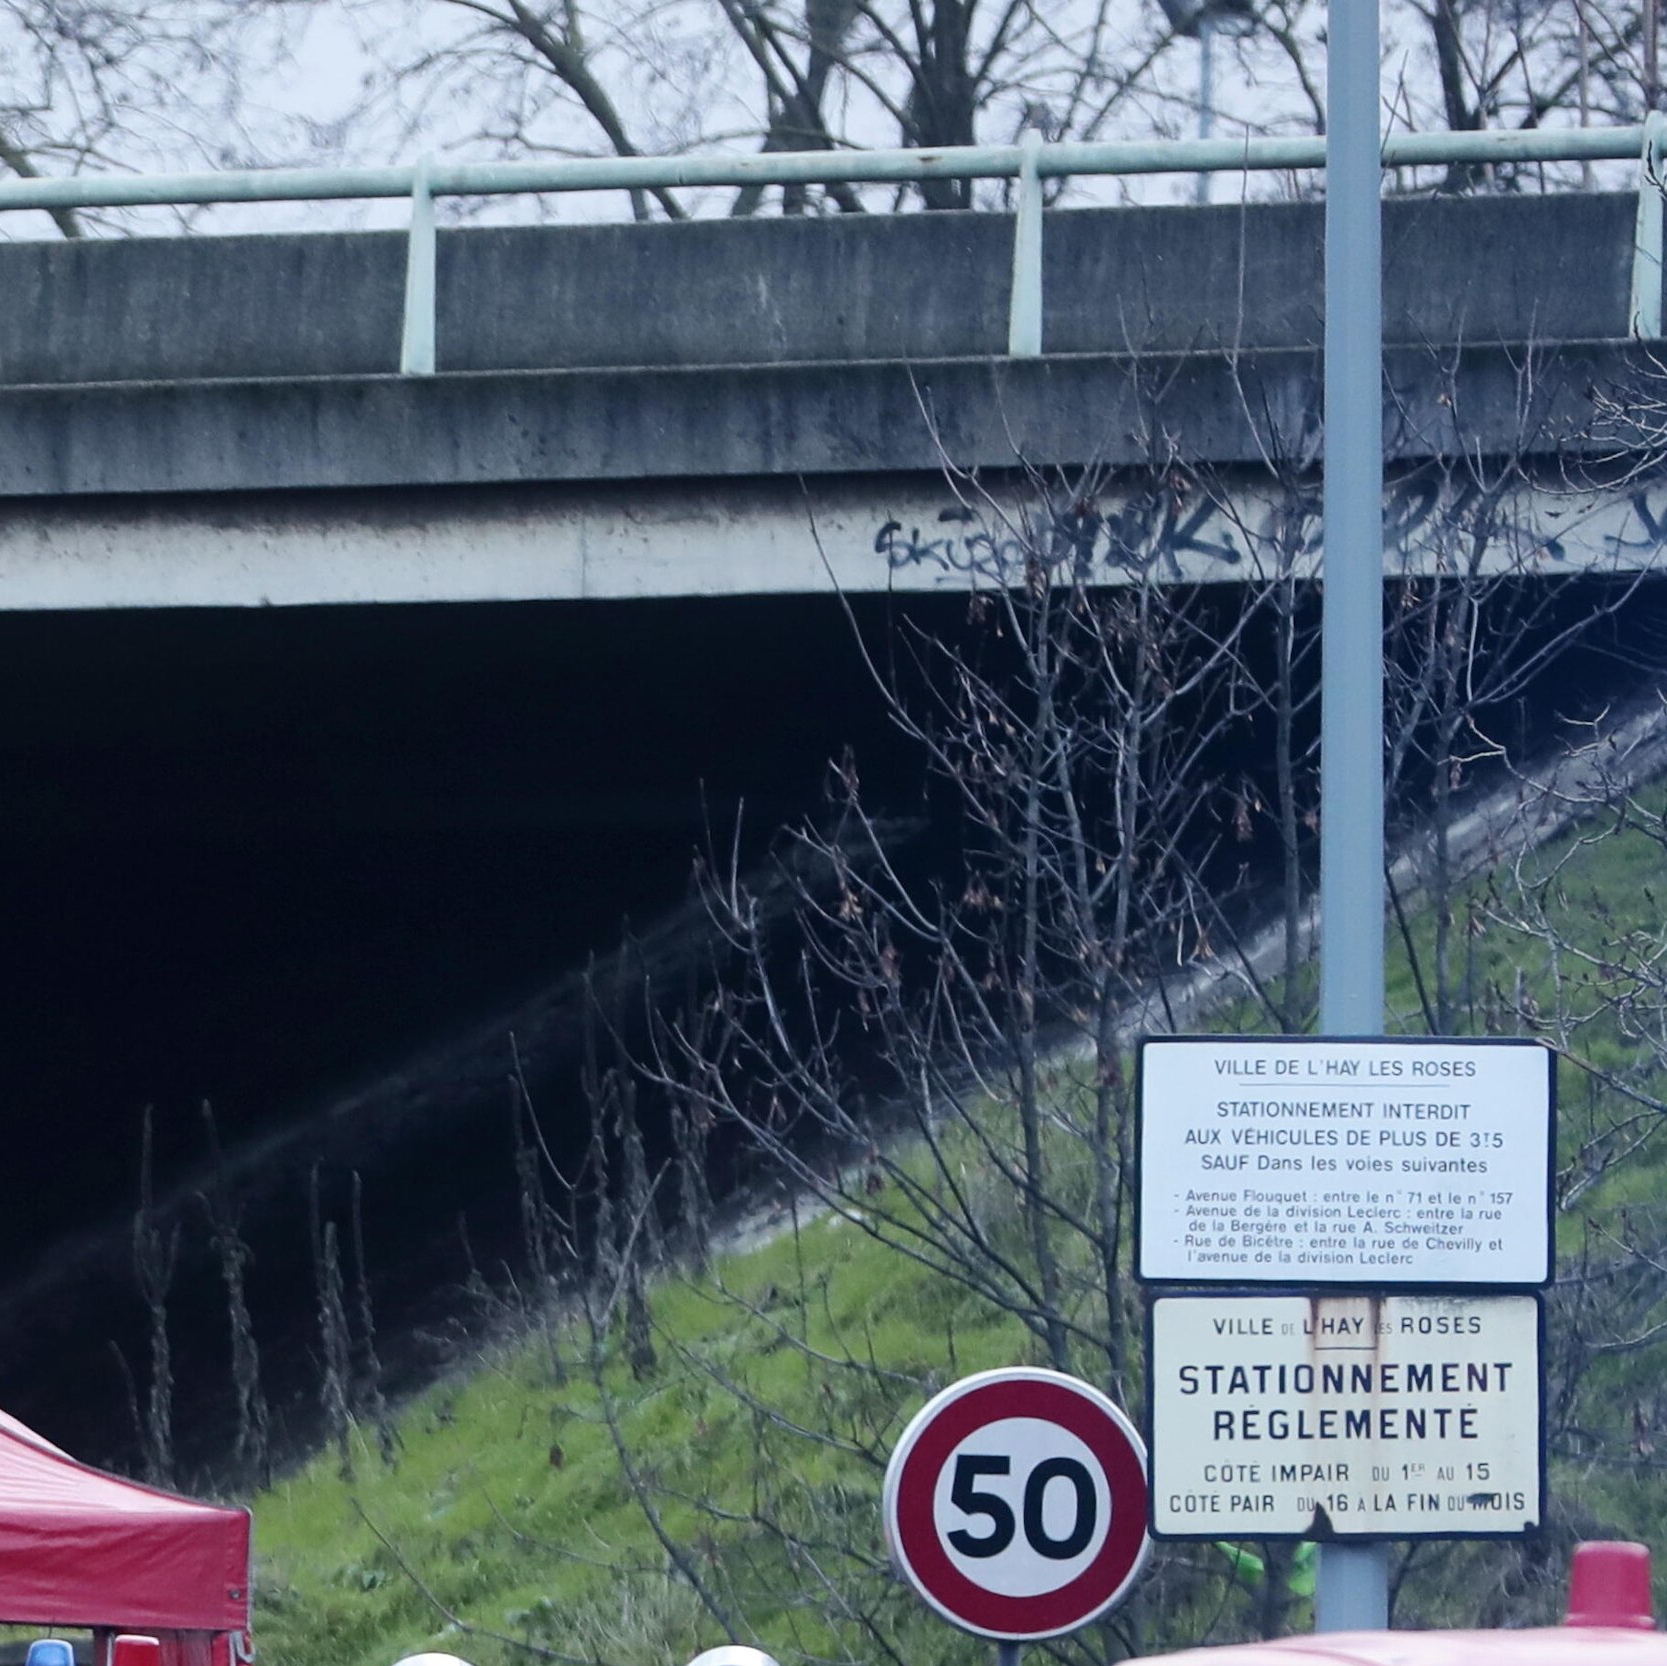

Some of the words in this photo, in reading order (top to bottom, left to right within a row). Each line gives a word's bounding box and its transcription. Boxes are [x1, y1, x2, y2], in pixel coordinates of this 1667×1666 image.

[1214, 1060, 1266, 1075] VILLE
[1275, 1060, 1299, 1075] DE
[1307, 1060, 1361, 1076] L'HAY
[1369, 1061, 1403, 1076] LES
[1412, 1061, 1476, 1077] ROSES
[1217, 1102, 1375, 1119] STATIONNEMENT
[1383, 1104, 1471, 1120] INTERDIT
[1184, 1129, 1221, 1144] AUX
[1232, 1127, 1338, 1145] VÉHICULES
[1346, 1130, 1370, 1145] DE
[1379, 1130, 1426, 1146] PLUS
[1436, 1131, 1461, 1147] DE
[1201, 1154, 1249, 1170] SAUF
[1257, 1154, 1302, 1171] Dans
[1311, 1156, 1337, 1171] les
[1346, 1157, 1393, 1172] voies
[1401, 1157, 1488, 1173] suivantes
[1186, 1190, 1237, 1201] Avenue
[1243, 1189, 1307, 1204] Flouquet
[1323, 1191, 1360, 1202] entre
[1367, 1191, 1379, 1203] le
[1408, 1192, 1422, 1204] 71
[1428, 1192, 1442, 1204] et
[1448, 1192, 1462, 1204] le
[1490, 1193, 1513, 1205] 157
[1186, 1205, 1237, 1217] Avenue
[1244, 1205, 1261, 1217] de
[1267, 1205, 1279, 1217] la
[1286, 1206, 1341, 1218] division
[1347, 1207, 1401, 1219] Leclerc
[1417, 1208, 1454, 1219] entre
[1461, 1208, 1473, 1220] la
[1479, 1209, 1502, 1220] rue
[1188, 1220, 1206, 1232] de
[1213, 1220, 1225, 1232] la
[1294, 1221, 1308, 1233] et
[1315, 1222, 1327, 1233] la
[1333, 1223, 1356, 1233] rue
[1384, 1222, 1463, 1235] Schweitzer
[1185, 1235, 1212, 1247] Rue
[1218, 1235, 1235, 1247] de
[1310, 1237, 1347, 1248] entre
[1354, 1237, 1366, 1249] la
[1372, 1239, 1395, 1249] rue
[1402, 1238, 1419, 1249] de
[1426, 1237, 1482, 1252] Chevilly
[1489, 1238, 1503, 1250] et
[1188, 1250, 1248, 1262] l'avenue
[1254, 1251, 1272, 1263] de
[1279, 1252, 1291, 1263] la
[1297, 1252, 1353, 1264] division
[1359, 1252, 1414, 1264] Leclerc
[1213, 1318, 1273, 1335] VILLE
[1282, 1323, 1295, 1335] DE
[1304, 1317, 1364, 1335] LHAY
[1401, 1316, 1482, 1334] ROSES
[1179, 1363, 1513, 1395] STATIONNEMENT
[1271, 1464, 1350, 1482] IMPAIR
[1372, 1466, 1390, 1481] DU
[1437, 1466, 1454, 1481] AU
[1466, 1463, 1490, 1480] 15
[947, 1454, 1097, 1560] 50
[1230, 1495, 1275, 1513] PAIR
[1297, 1497, 1315, 1512] DU
[1327, 1494, 1348, 1511] 16
[1373, 1494, 1397, 1512] LA
[1407, 1494, 1440, 1512] FIN
[1447, 1495, 1465, 1511] DU
